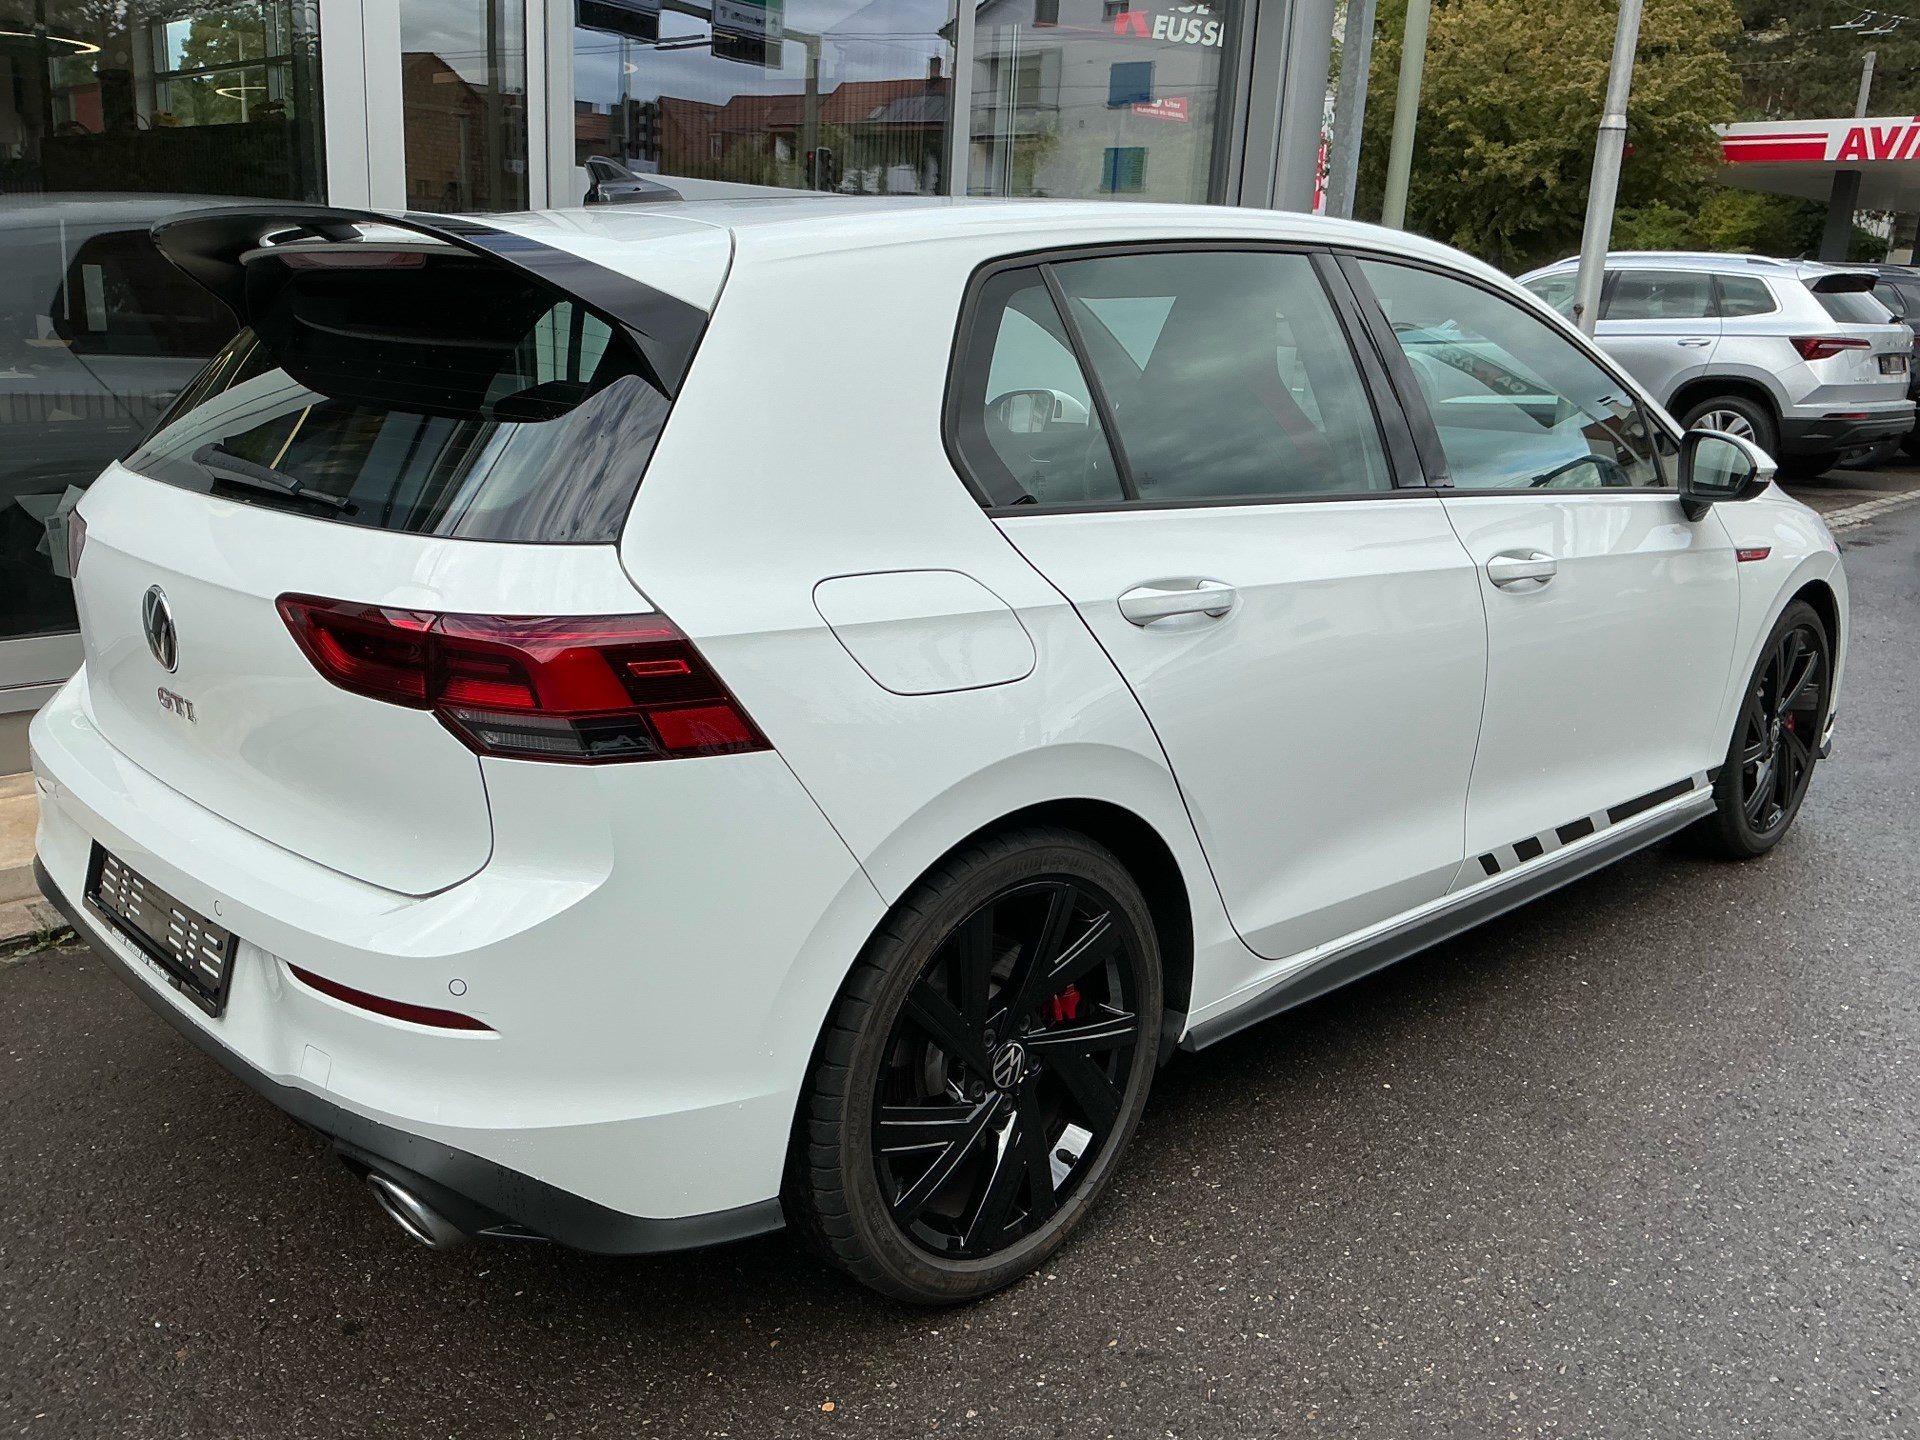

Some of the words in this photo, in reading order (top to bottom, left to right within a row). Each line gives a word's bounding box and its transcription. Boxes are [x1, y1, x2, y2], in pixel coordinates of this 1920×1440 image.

[1114, 11, 1224, 46] EUSS
[1836, 127, 1920, 160] AVI
[157, 686, 197, 724] GTI
